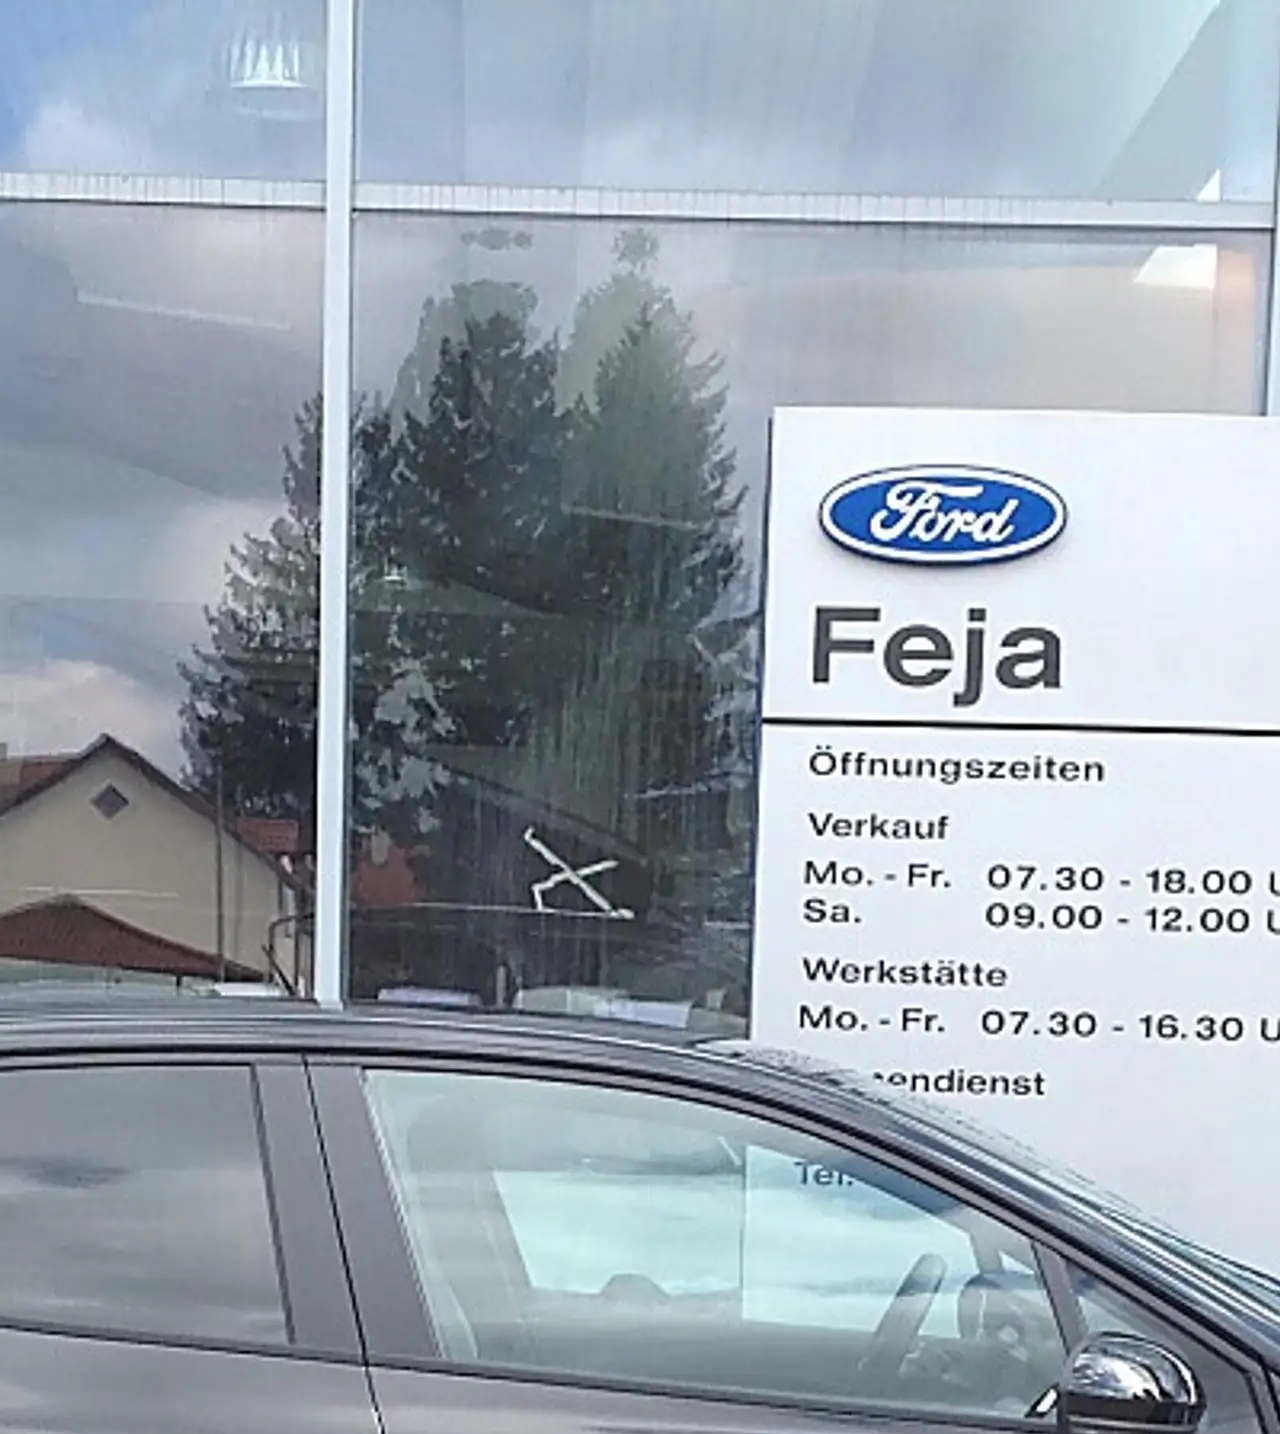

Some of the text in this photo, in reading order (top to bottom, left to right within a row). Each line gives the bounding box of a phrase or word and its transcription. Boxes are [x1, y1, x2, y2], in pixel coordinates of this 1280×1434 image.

[871, 480, 1019, 542] Ford
[812, 606, 1062, 708] Feja
[809, 745, 1105, 785] Öffnungszeiten
[808, 812, 950, 841] Verkauf
[804, 861, 874, 888] Mo.
[908, 864, 951, 888] Fr.
[987, 864, 1104, 892] 07.30
[1146, 869, 1253, 896] 18.00
[804, 898, 862, 925] Sa.
[985, 902, 1103, 930] 09.00
[1145, 907, 1250, 934] 12.00
[802, 957, 1007, 988] Werkstätte
[799, 1004, 868, 1032] Mo.
[901, 1007, 945, 1033] Fr.
[981, 1010, 1097, 1038] 07.30
[1139, 1014, 1244, 1042] 16.30
[874, 1069, 1046, 1096] endienst
